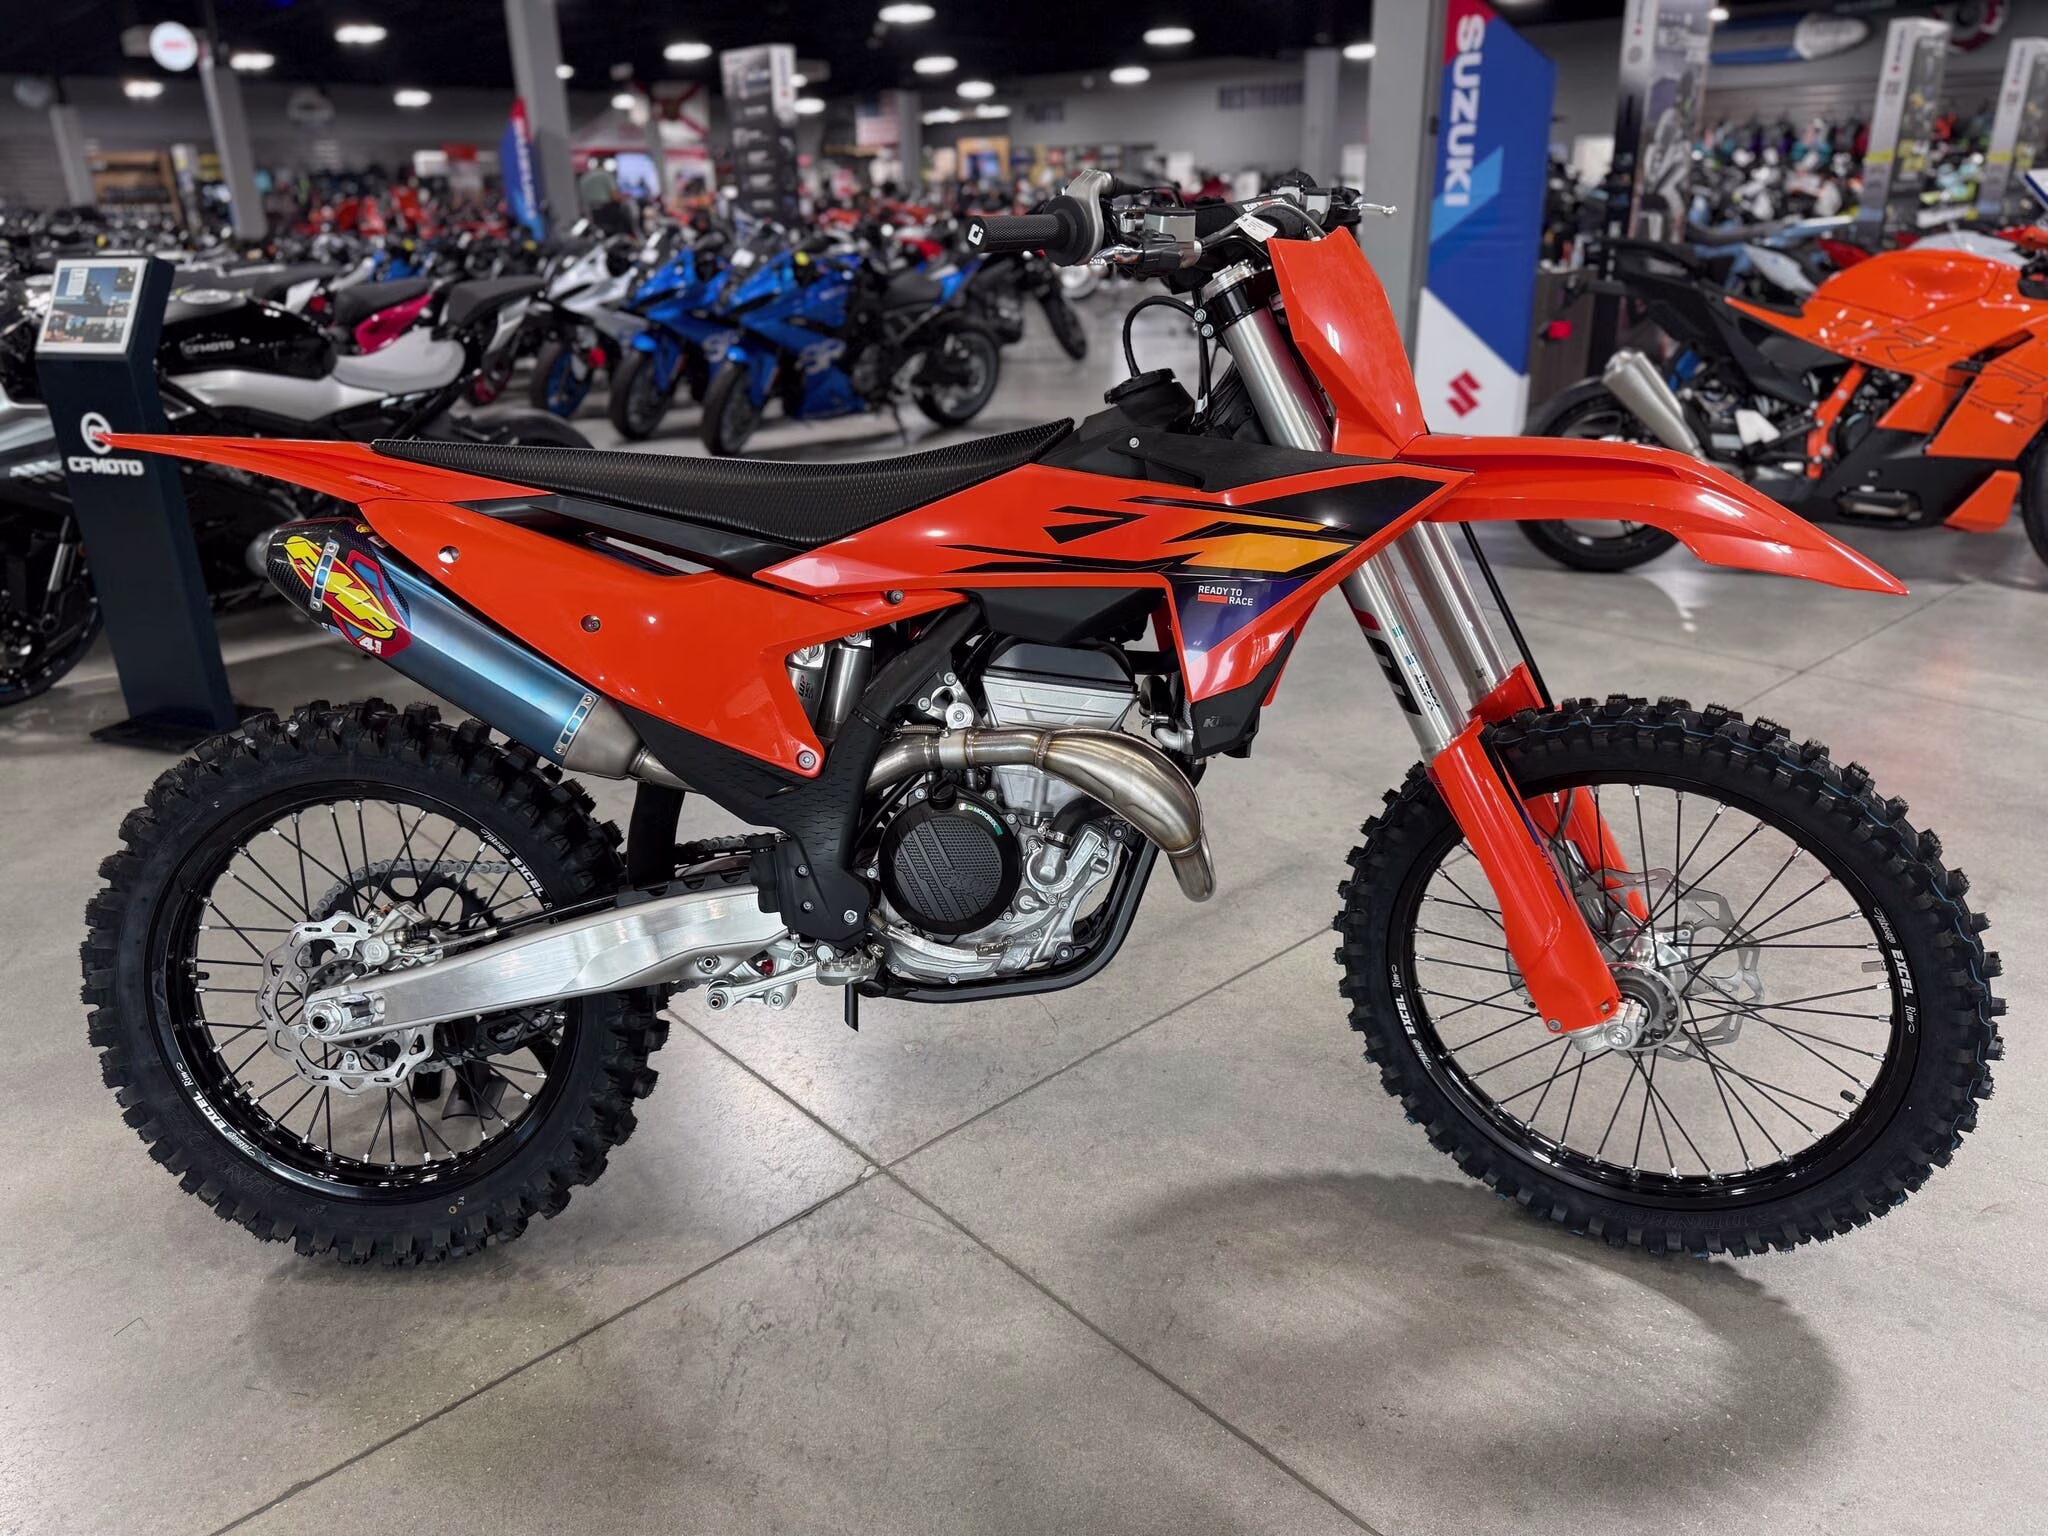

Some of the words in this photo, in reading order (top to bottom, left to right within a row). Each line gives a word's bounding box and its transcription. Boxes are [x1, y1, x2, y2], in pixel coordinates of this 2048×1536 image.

[1444, 14, 1486, 207] SUZUKI
[68, 456, 145, 476] CFMOTO
[1198, 585, 1229, 596] READY
[1231, 588, 1243, 596] TO
[1228, 596, 1254, 606] RACE
[973, 807, 998, 828] MOTOREX
[510, 856, 544, 897] EXCEL
[1891, 949, 1914, 998] EXCEL
[1905, 1004, 1916, 1034] Rim
[1395, 994, 1416, 1035] EXCEL
[176, 1062, 194, 1087] Rim
[192, 1090, 228, 1136] EXCEL
